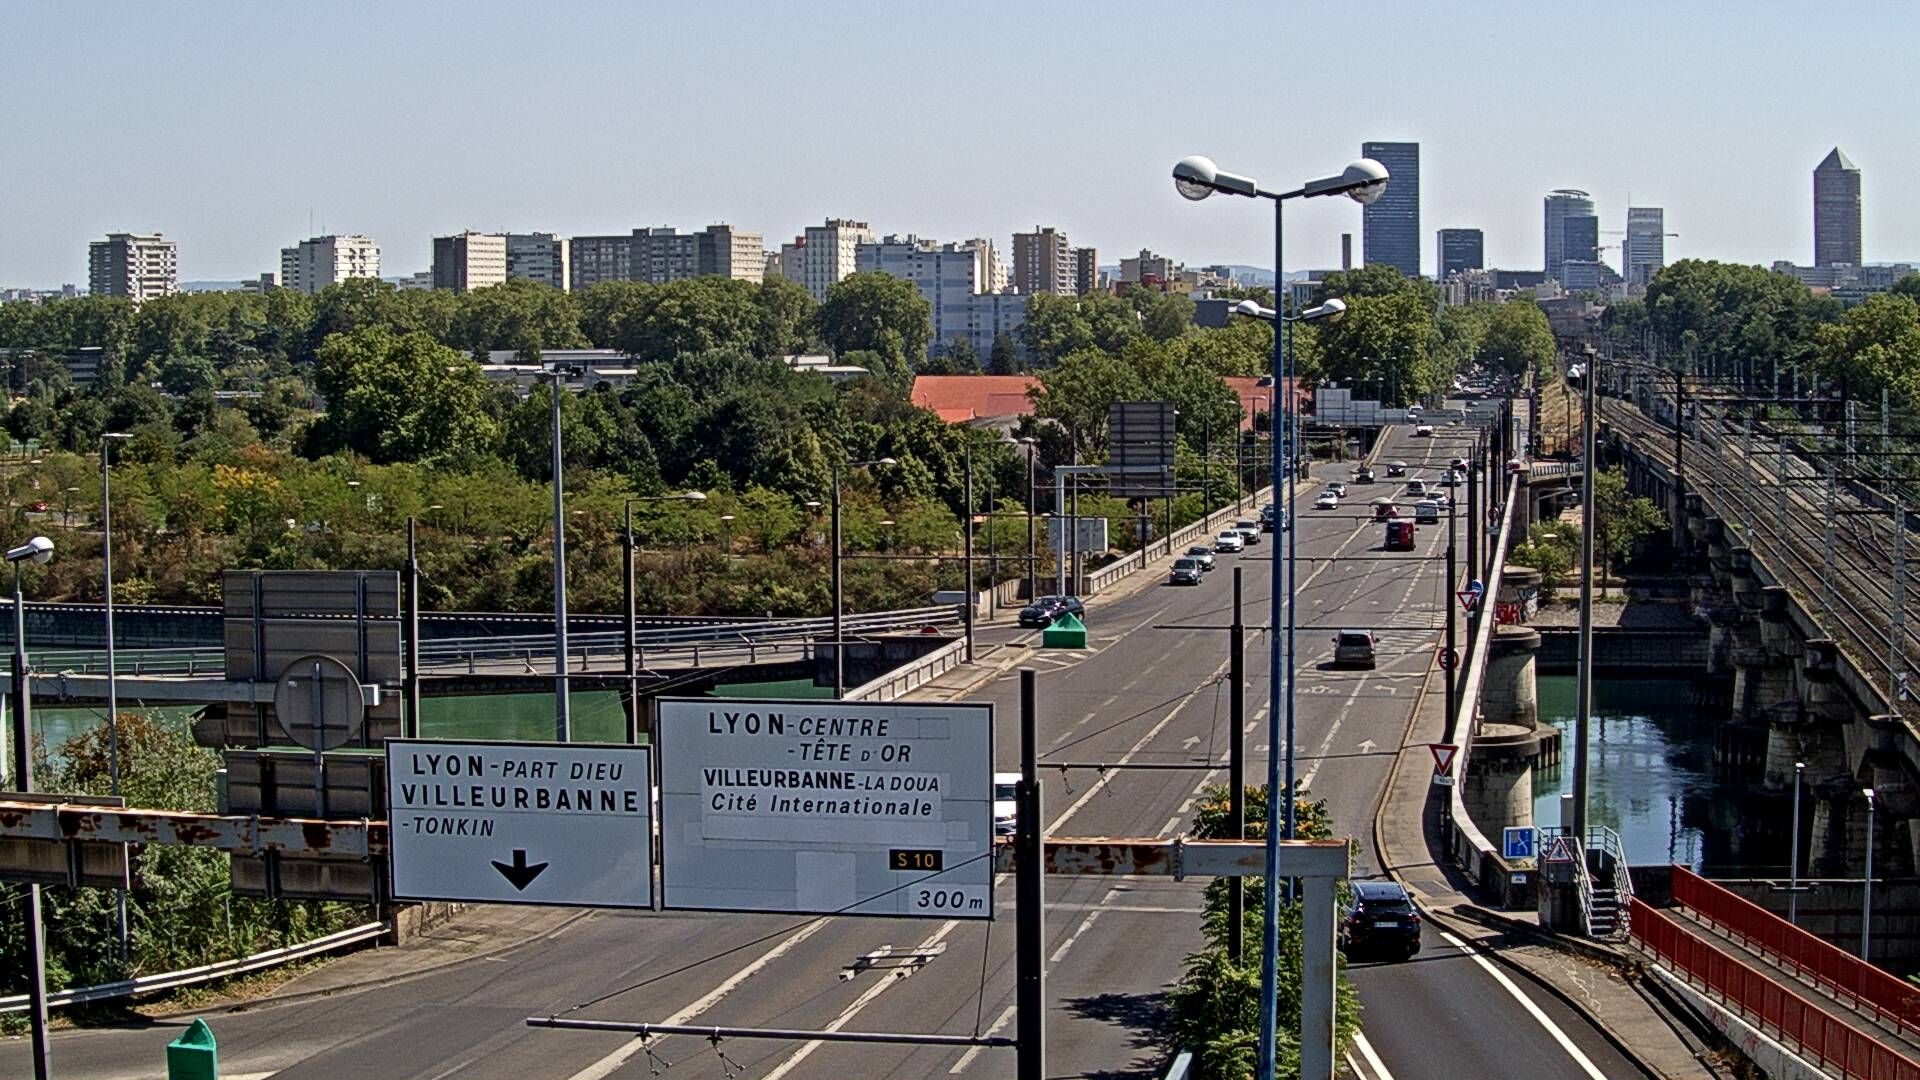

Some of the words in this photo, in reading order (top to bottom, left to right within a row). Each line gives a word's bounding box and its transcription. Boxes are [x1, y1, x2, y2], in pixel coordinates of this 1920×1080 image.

[569, 763, 623, 780] DIEU
[890, 777, 940, 792] DOUA
[401, 783, 638, 812] VILLEURBANNE
[711, 792, 757, 811] Cité
[770, 794, 933, 816] Internationale
[917, 890, 964, 909] 300
[969, 898, 983, 910] m
